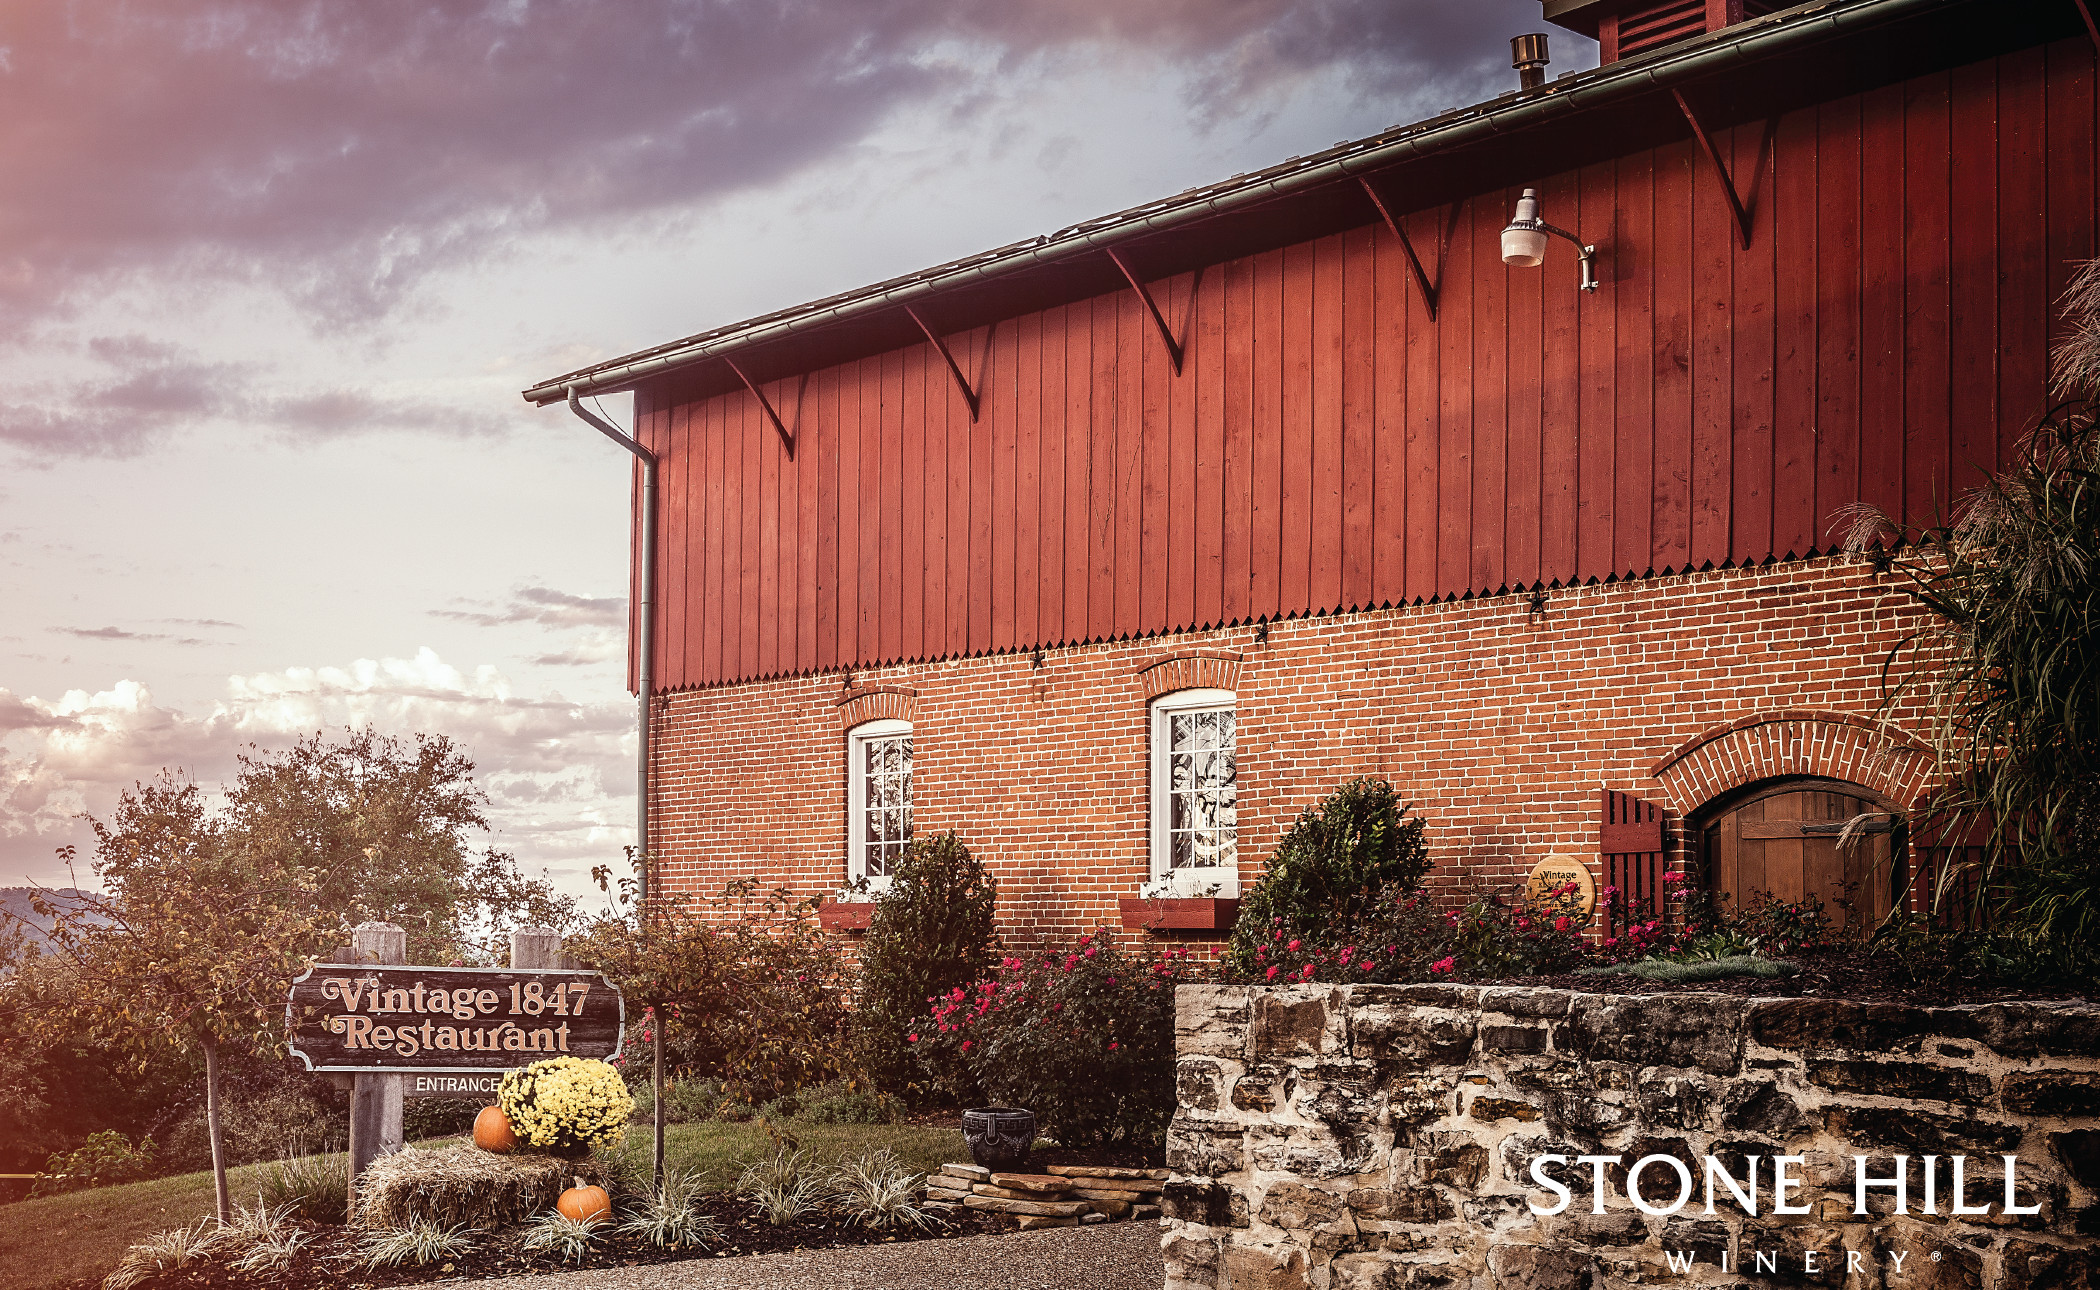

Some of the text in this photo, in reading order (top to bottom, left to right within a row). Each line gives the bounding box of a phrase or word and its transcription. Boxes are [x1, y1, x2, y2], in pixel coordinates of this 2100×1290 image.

[1543, 870, 1577, 882] Vintage
[320, 977, 591, 1020] Vintage 1847
[329, 1015, 571, 1057] Restaurant
[416, 1077, 500, 1092] ENTRANCE
